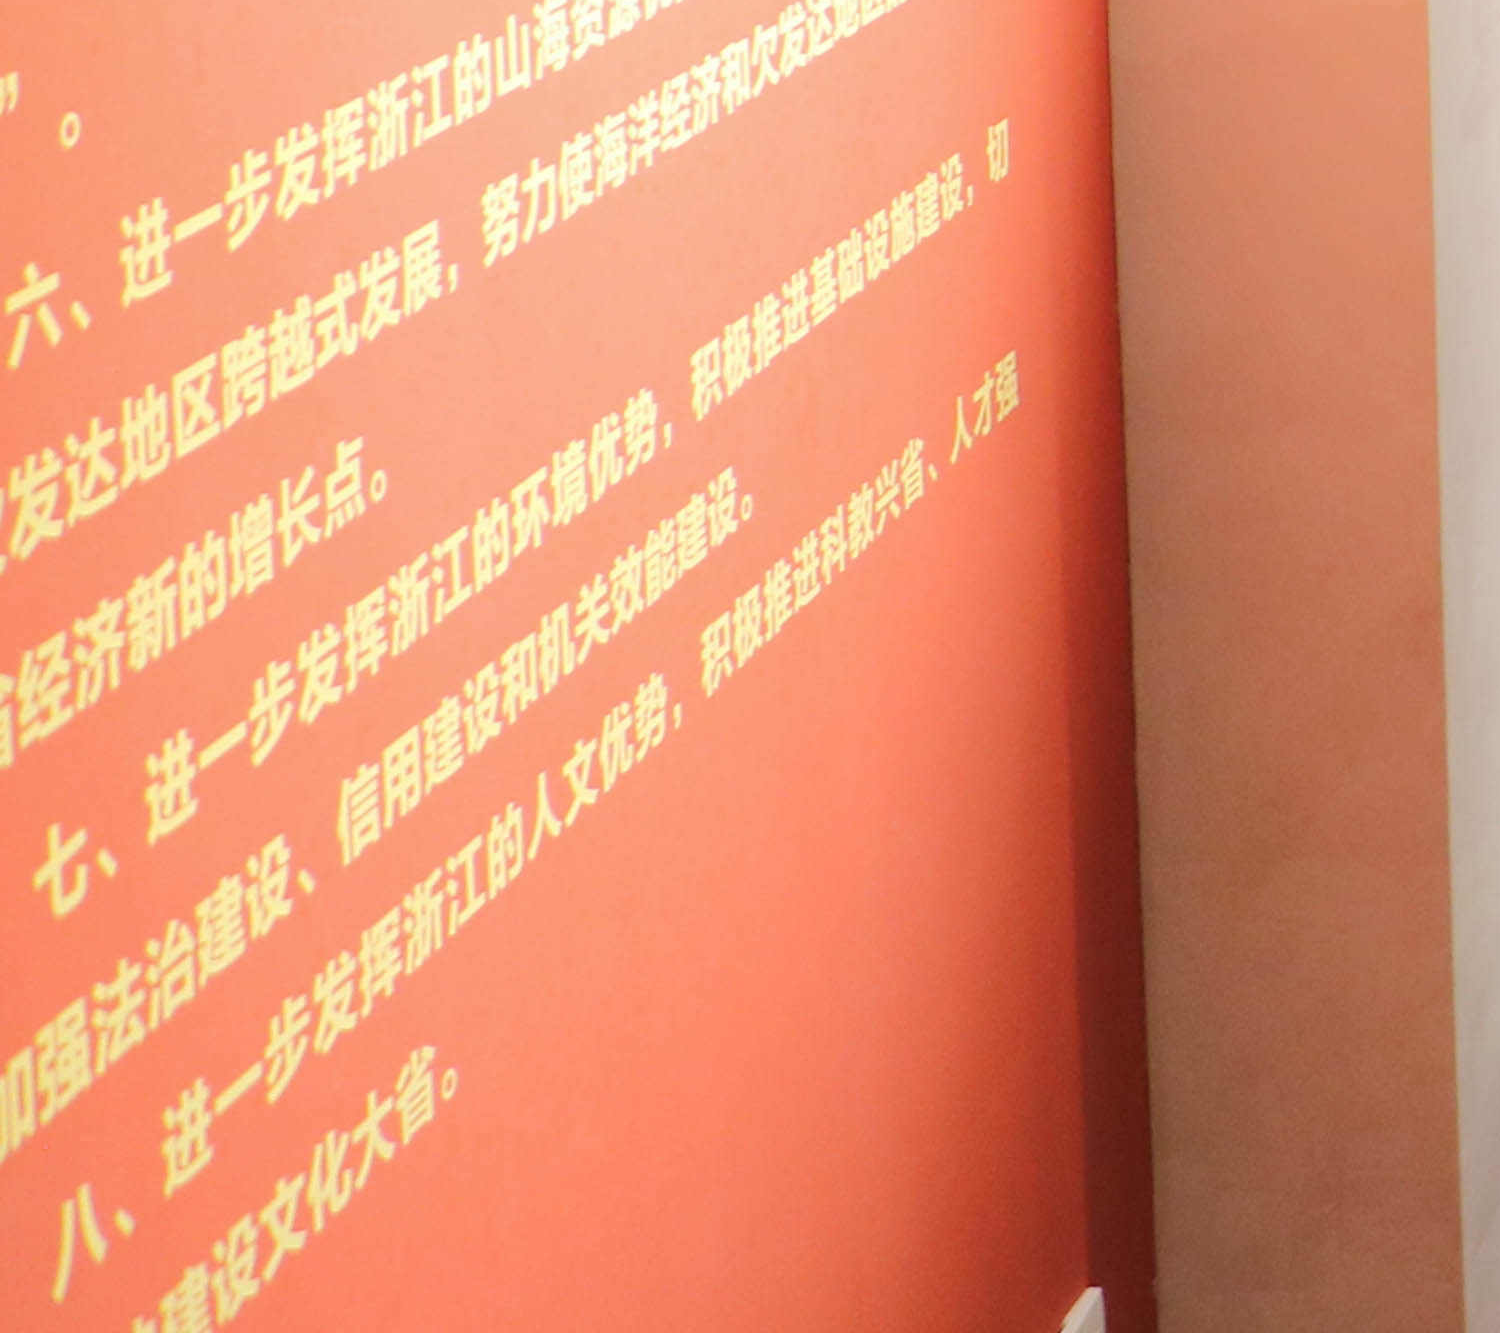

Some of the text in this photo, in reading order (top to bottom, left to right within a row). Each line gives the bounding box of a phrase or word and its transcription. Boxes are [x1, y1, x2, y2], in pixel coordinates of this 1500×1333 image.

[129, 1043, 459, 1333] 建设文化大省。
